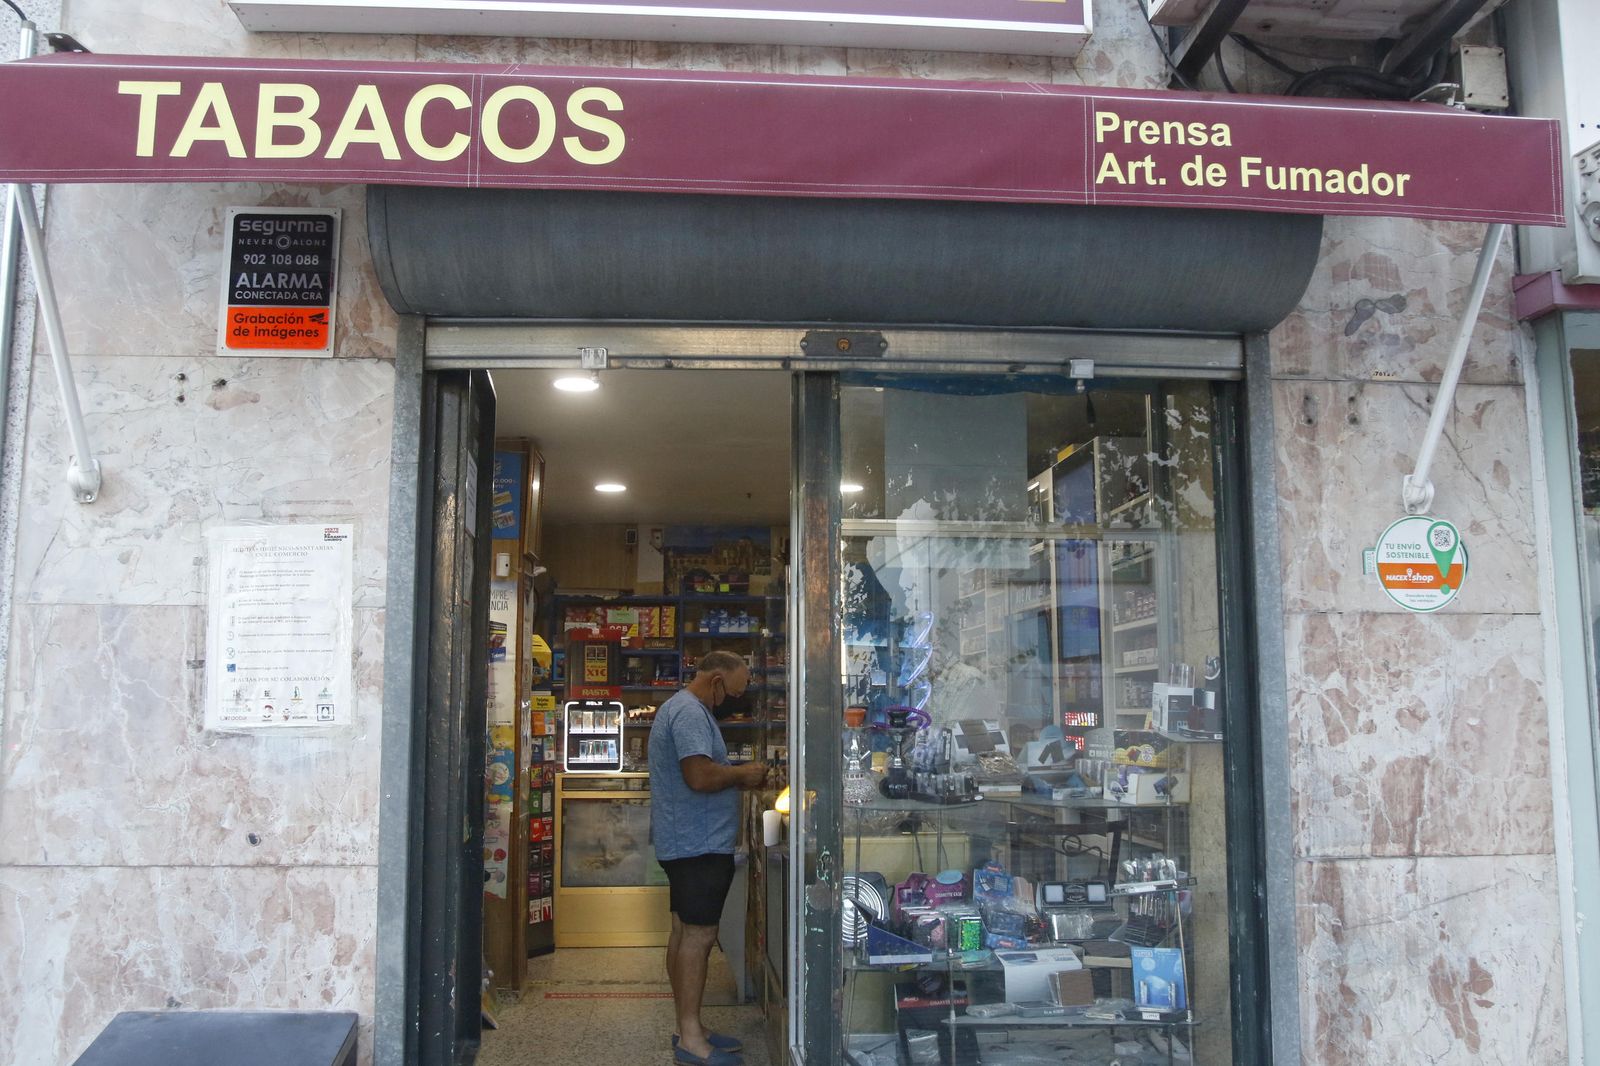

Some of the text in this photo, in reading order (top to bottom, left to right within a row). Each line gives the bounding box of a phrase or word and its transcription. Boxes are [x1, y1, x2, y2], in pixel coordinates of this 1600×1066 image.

[118, 80, 626, 165] TABACOS
[1095, 111, 1232, 147] Prensa
[1095, 152, 1411, 197] Art. de Fumador
[239, 219, 328, 235] segurma
[238, 238, 327, 247] NEVER ALONE
[243, 253, 320, 266] 902 108 088
[235, 272, 324, 289] ALARMA
[234, 290, 323, 301] CONECTADA CRA
[233, 311, 304, 325] Grabación
[232, 325, 320, 340] de imágenes
[1385, 551, 1430, 559] SOSTENIBLE
[581, 688, 610, 696] RASTA
